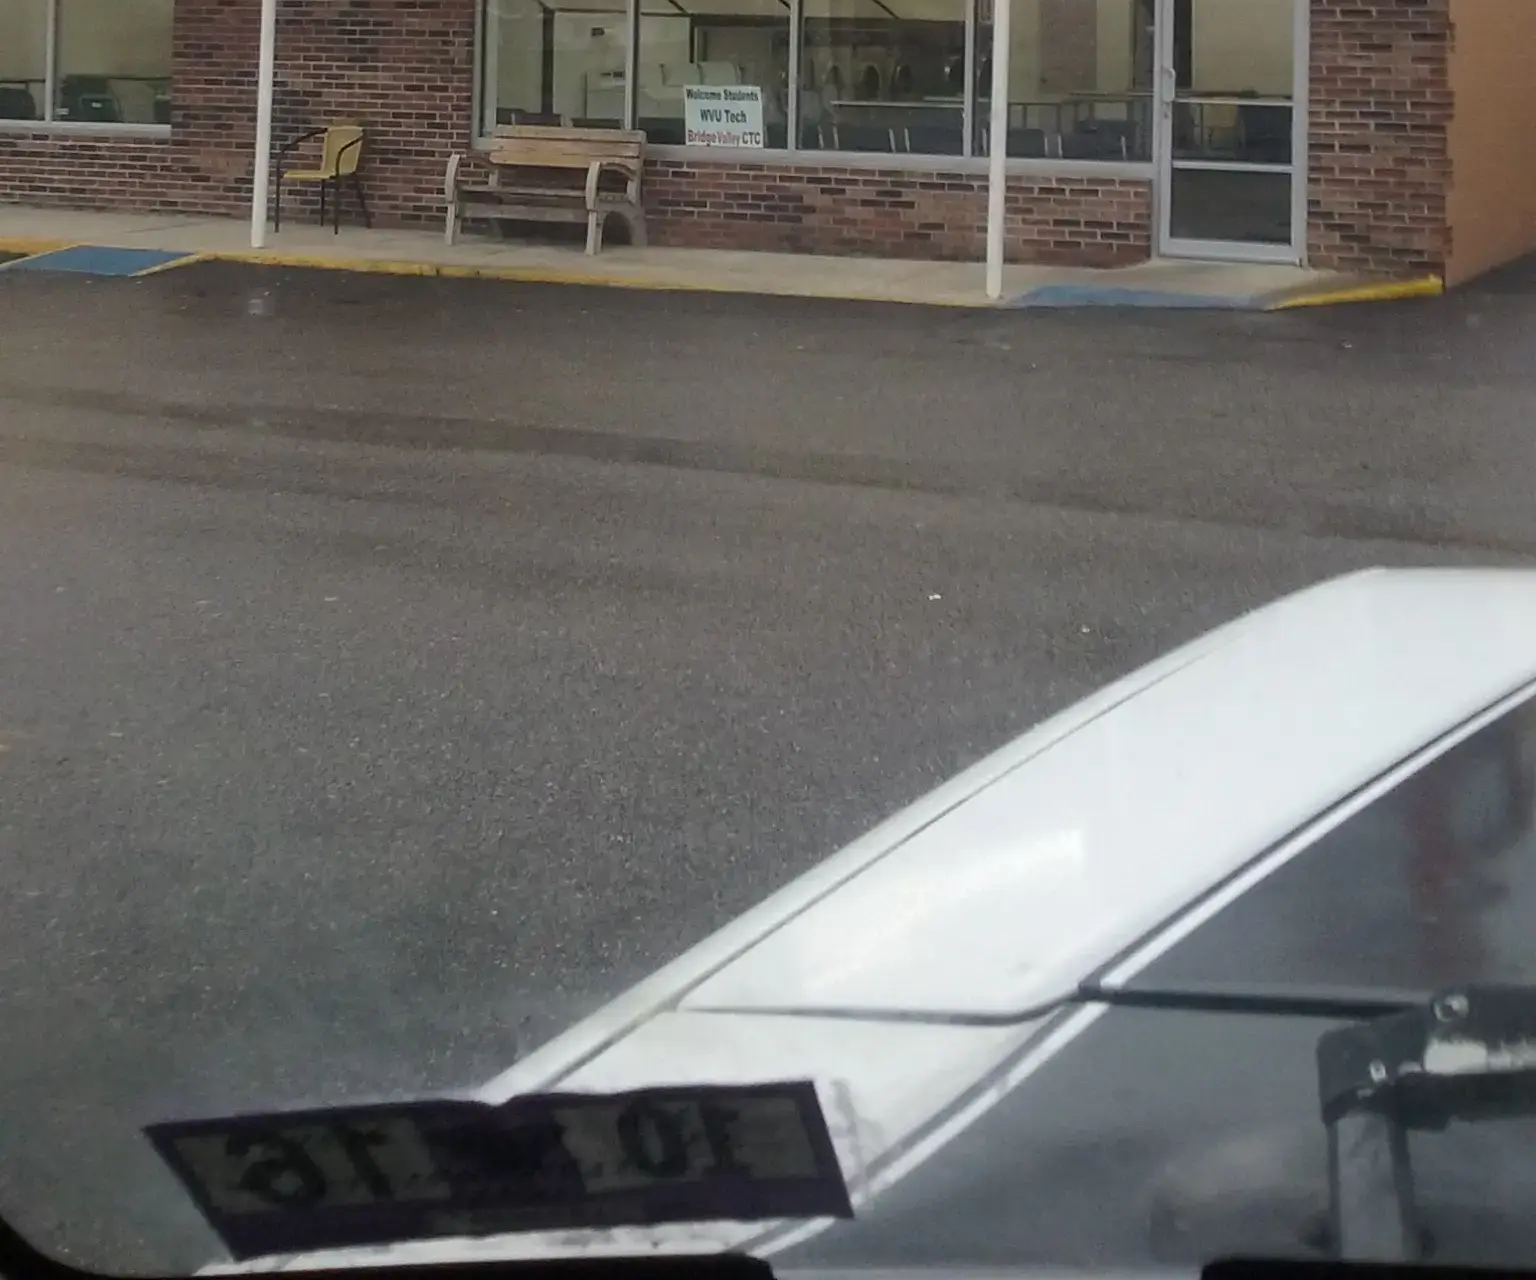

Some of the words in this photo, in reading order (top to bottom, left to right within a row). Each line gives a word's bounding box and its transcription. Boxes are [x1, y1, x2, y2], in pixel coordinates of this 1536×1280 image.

[686, 88, 721, 101] Welcome
[723, 89, 759, 101] Students
[700, 109, 722, 122] WVU
[724, 110, 747, 123] Tech
[743, 131, 761, 145] CTC
